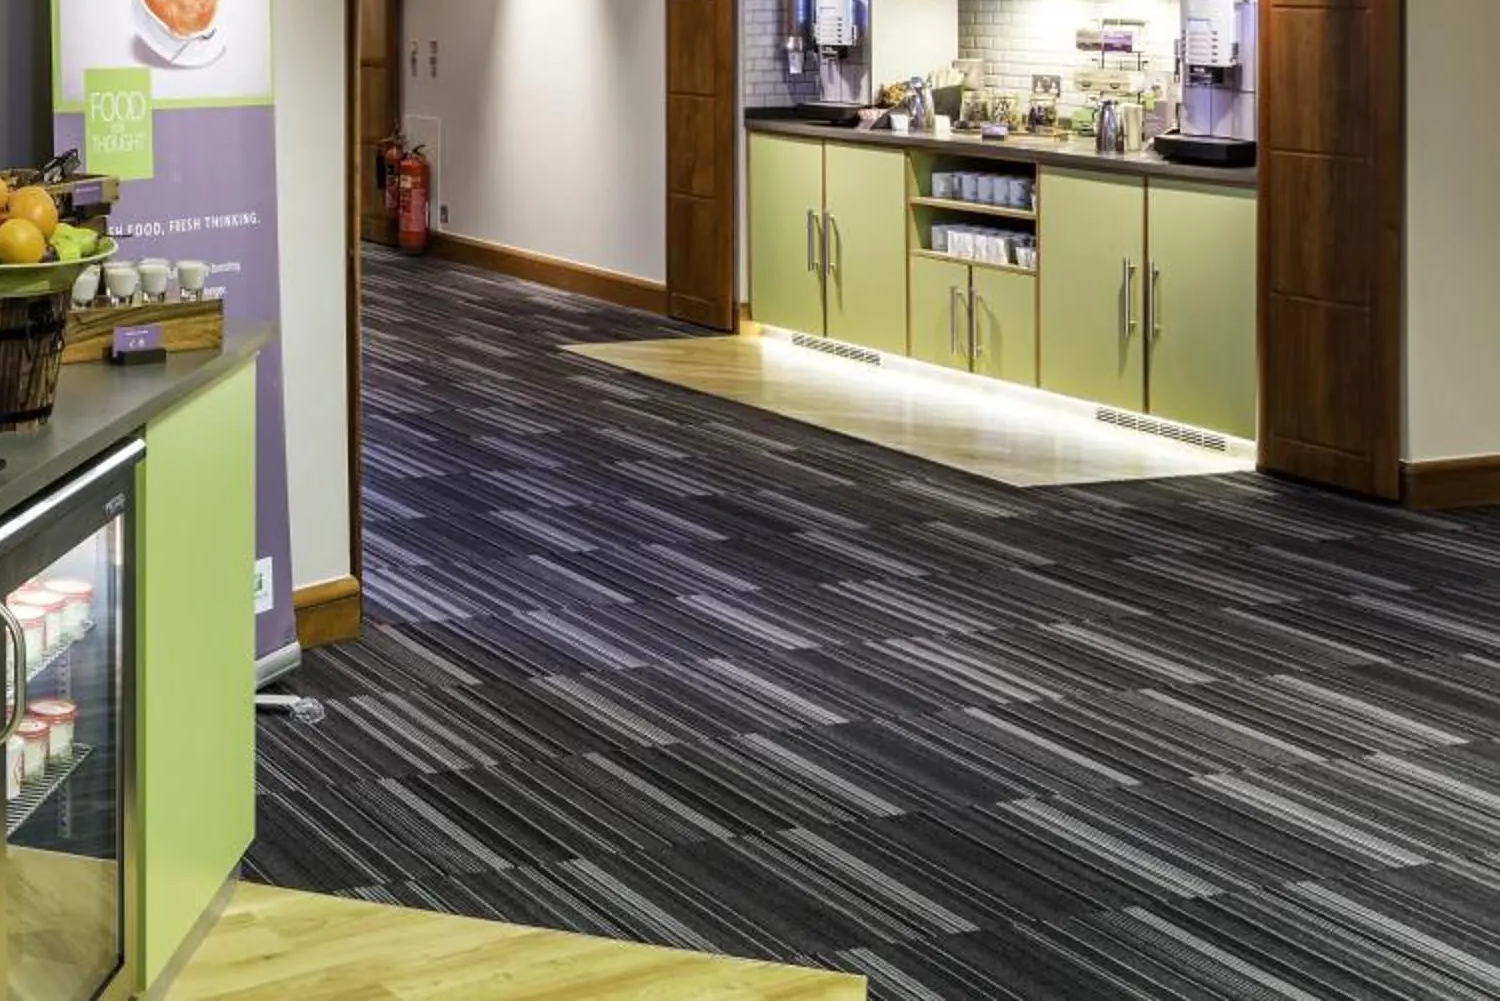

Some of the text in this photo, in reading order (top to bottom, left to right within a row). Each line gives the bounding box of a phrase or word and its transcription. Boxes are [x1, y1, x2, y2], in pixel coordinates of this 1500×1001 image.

[90, 90, 146, 122] FOOD
[92, 133, 145, 153] THOUGHT
[127, 222, 165, 237] FOOD,
[169, 216, 201, 233] FRESH
[204, 211, 261, 229] THINKING.
